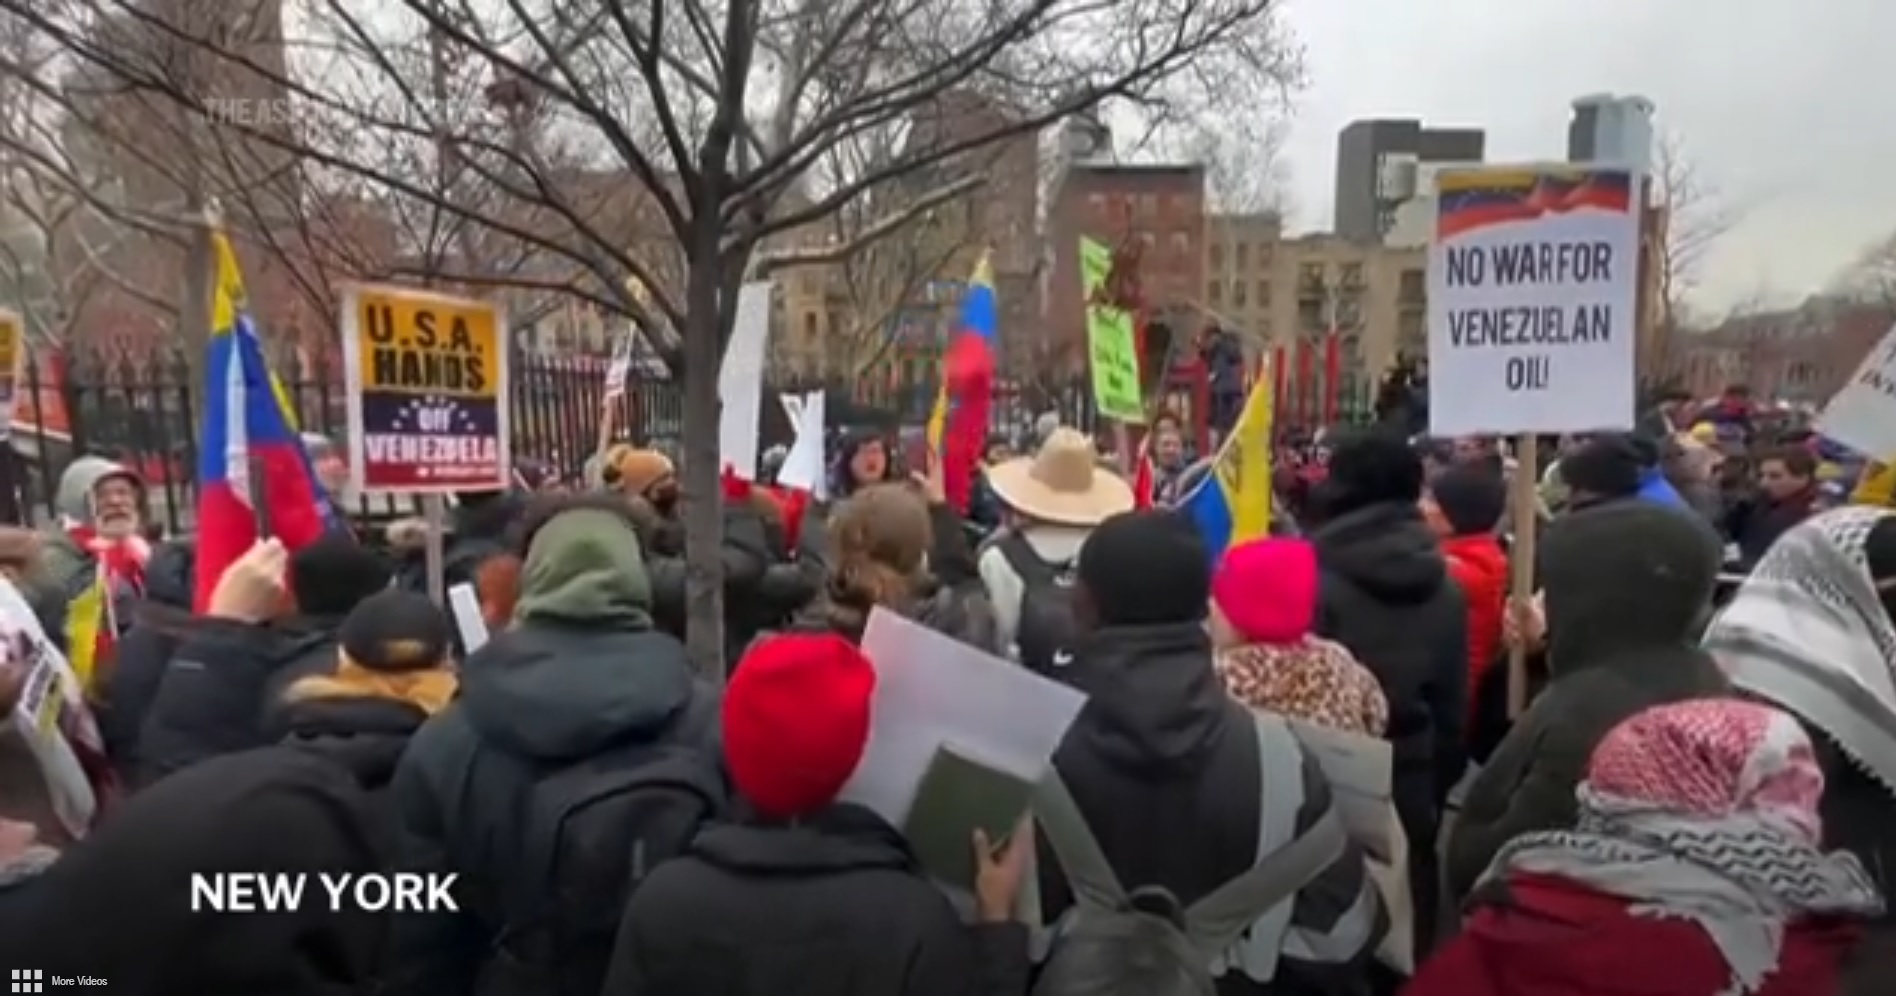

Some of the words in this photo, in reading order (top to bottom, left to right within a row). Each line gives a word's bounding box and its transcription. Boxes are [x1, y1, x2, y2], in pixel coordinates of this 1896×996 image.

[1447, 246, 1485, 286] NO
[1492, 243, 1551, 285] WAR
[1556, 241, 1613, 283] FOR
[366, 305, 483, 353] U.S.A.
[1448, 304, 1612, 347] VENEZUELAN
[374, 347, 485, 391] HANDS
[1506, 355, 1550, 390] OIL!
